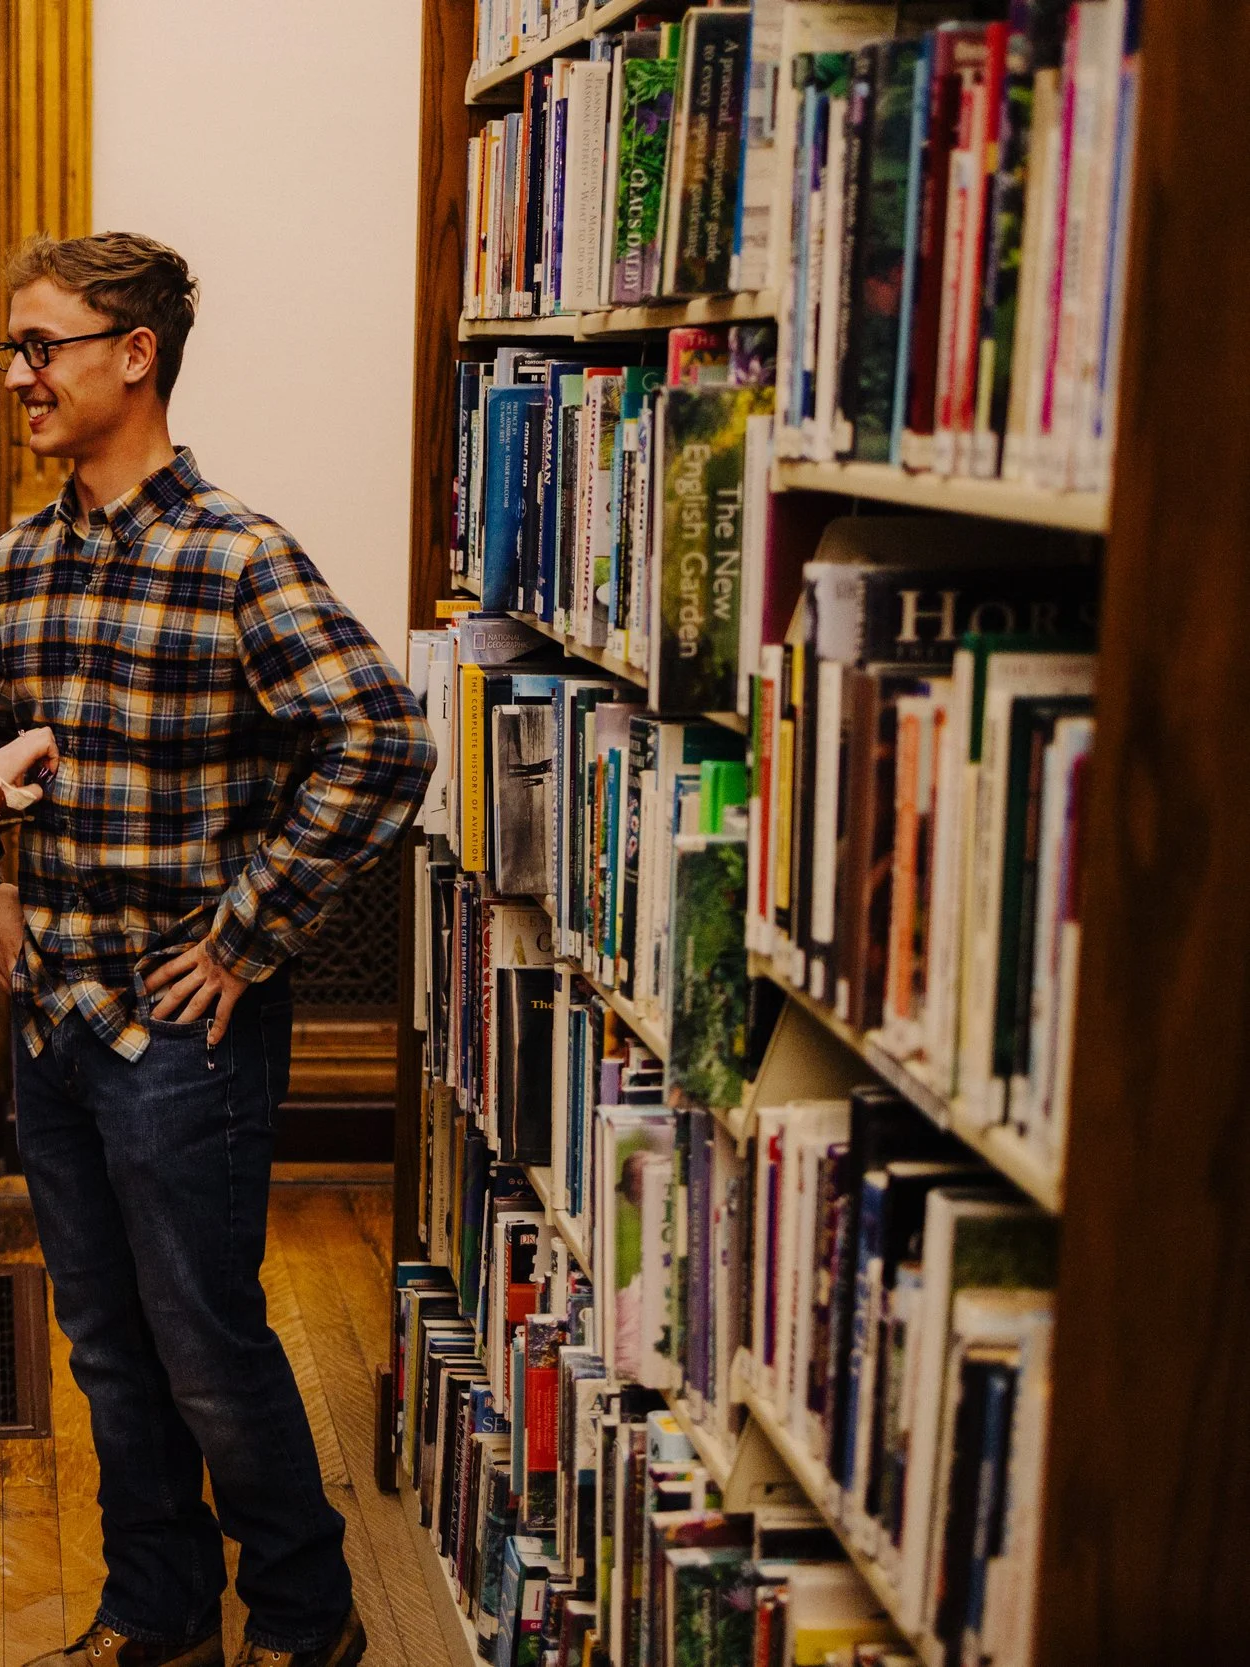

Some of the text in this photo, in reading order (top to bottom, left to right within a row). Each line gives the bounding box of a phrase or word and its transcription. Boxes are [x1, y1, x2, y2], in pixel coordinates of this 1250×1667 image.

[696, 65, 712, 108] every
[702, 45, 715, 61] to
[576, 71, 594, 298] SEASONAL INTEREST WHAT TO DO WHEN
[585, 78, 604, 293] PLANNING CREATING MAINTENANCE
[684, 184, 706, 259] gardening
[623, 169, 647, 292] CLAUS DALBY
[705, 221, 723, 263] guide
[542, 395, 554, 486] CHAPMAN
[583, 399, 597, 613] RUSTIC GARDEN PROJECTS
[638, 478, 646, 530] learn
[675, 443, 712, 660] English Garden
[712, 482, 744, 621] The New
[635, 557, 643, 628] garden
[487, 641, 529, 649] GEOGRAPHIC
[471, 799, 478, 811] OF
[482, 926, 494, 1023] CARS
[531, 1001, 554, 1009] The
[521, 1234, 535, 1244] DK
[450, 1408, 464, 1542] MICHIO KAKU
